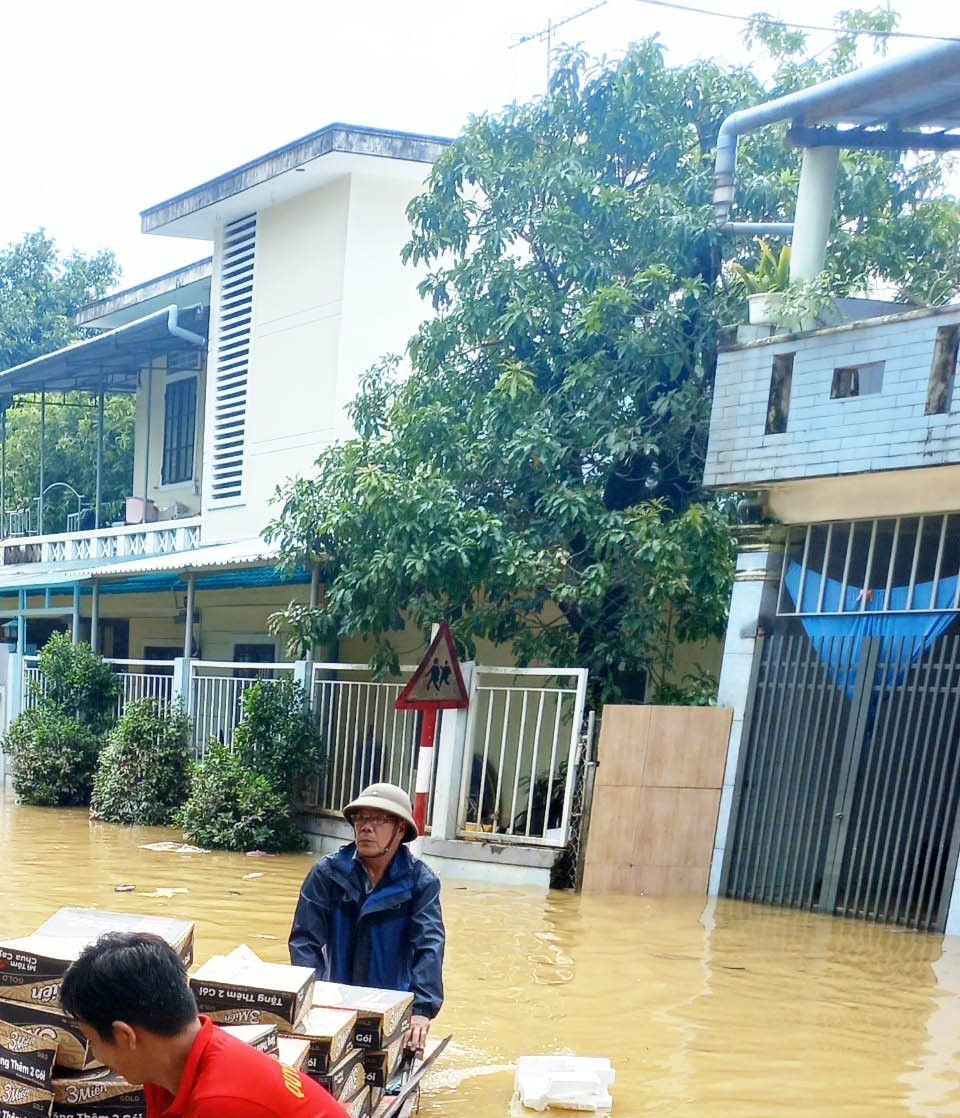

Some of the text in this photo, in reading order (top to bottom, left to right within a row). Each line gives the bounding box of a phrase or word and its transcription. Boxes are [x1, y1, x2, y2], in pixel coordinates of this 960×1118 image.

[16, 955, 37, 964] Chua
[2, 974, 24, 984] GOLD
[199, 987, 283, 1006] Tặng Thêm 2 Gói
[355, 1034, 372, 1043] Gói
[11, 1058, 29, 1076] Thêm
[30, 1067, 35, 1076] 2
[35, 1069, 46, 1081] Gói
